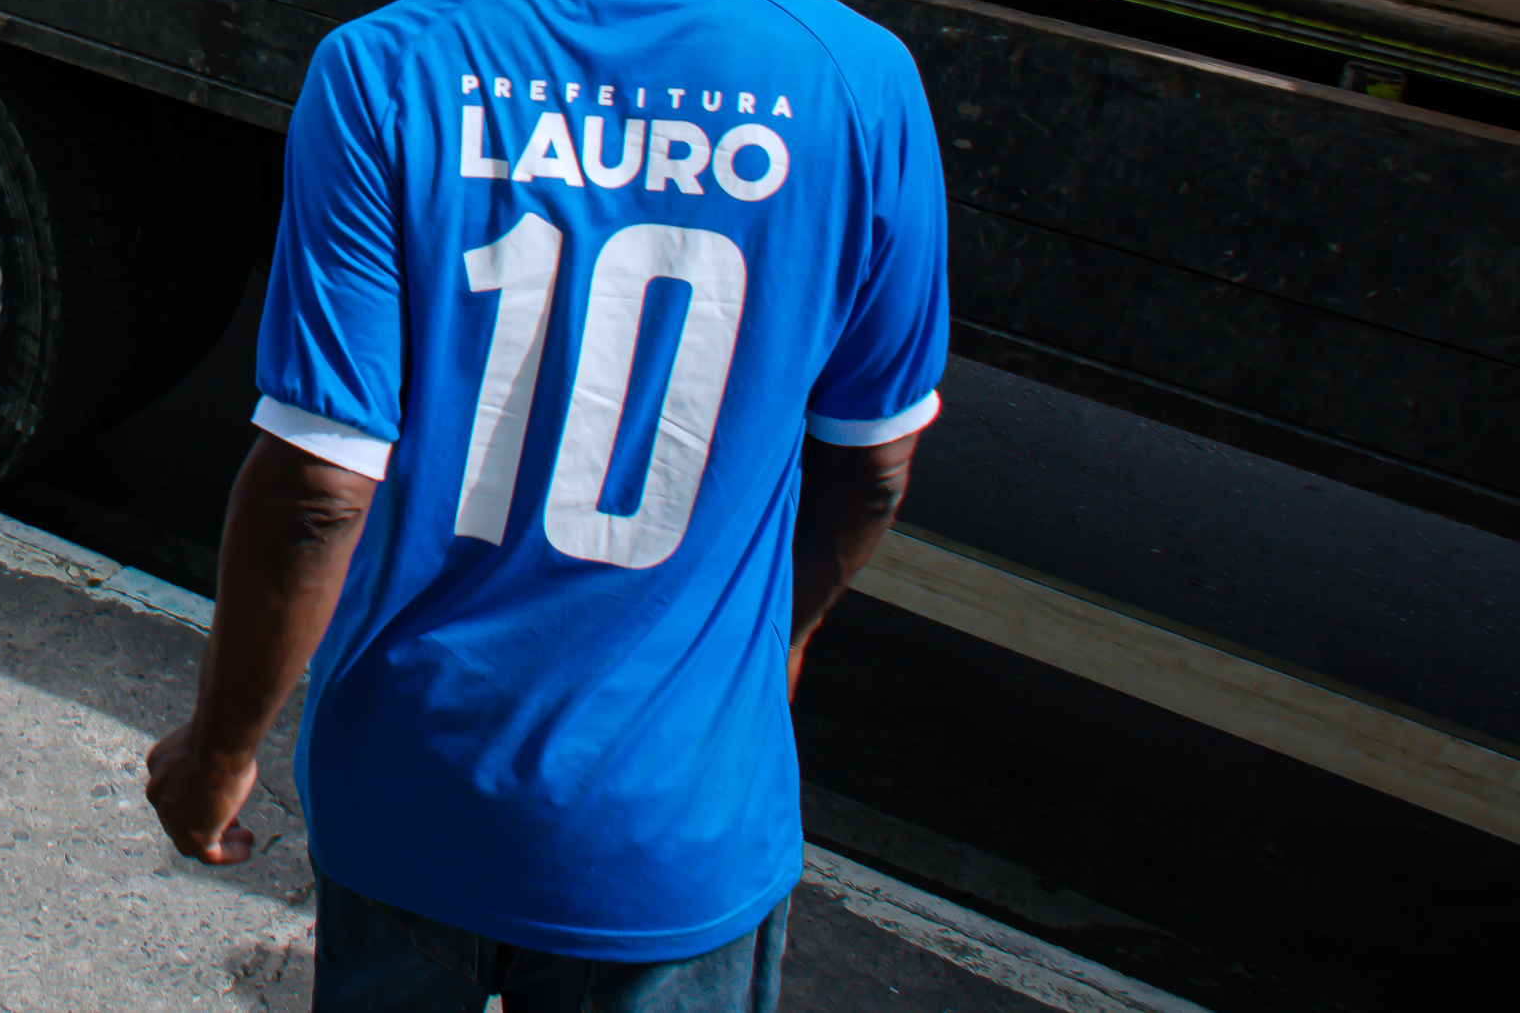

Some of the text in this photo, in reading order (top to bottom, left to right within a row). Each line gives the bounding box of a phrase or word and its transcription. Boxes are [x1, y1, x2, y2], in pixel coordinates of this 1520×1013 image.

[462, 74, 793, 118] PREFEITURA
[460, 105, 790, 202] LAURO
[454, 212, 747, 570] 10
